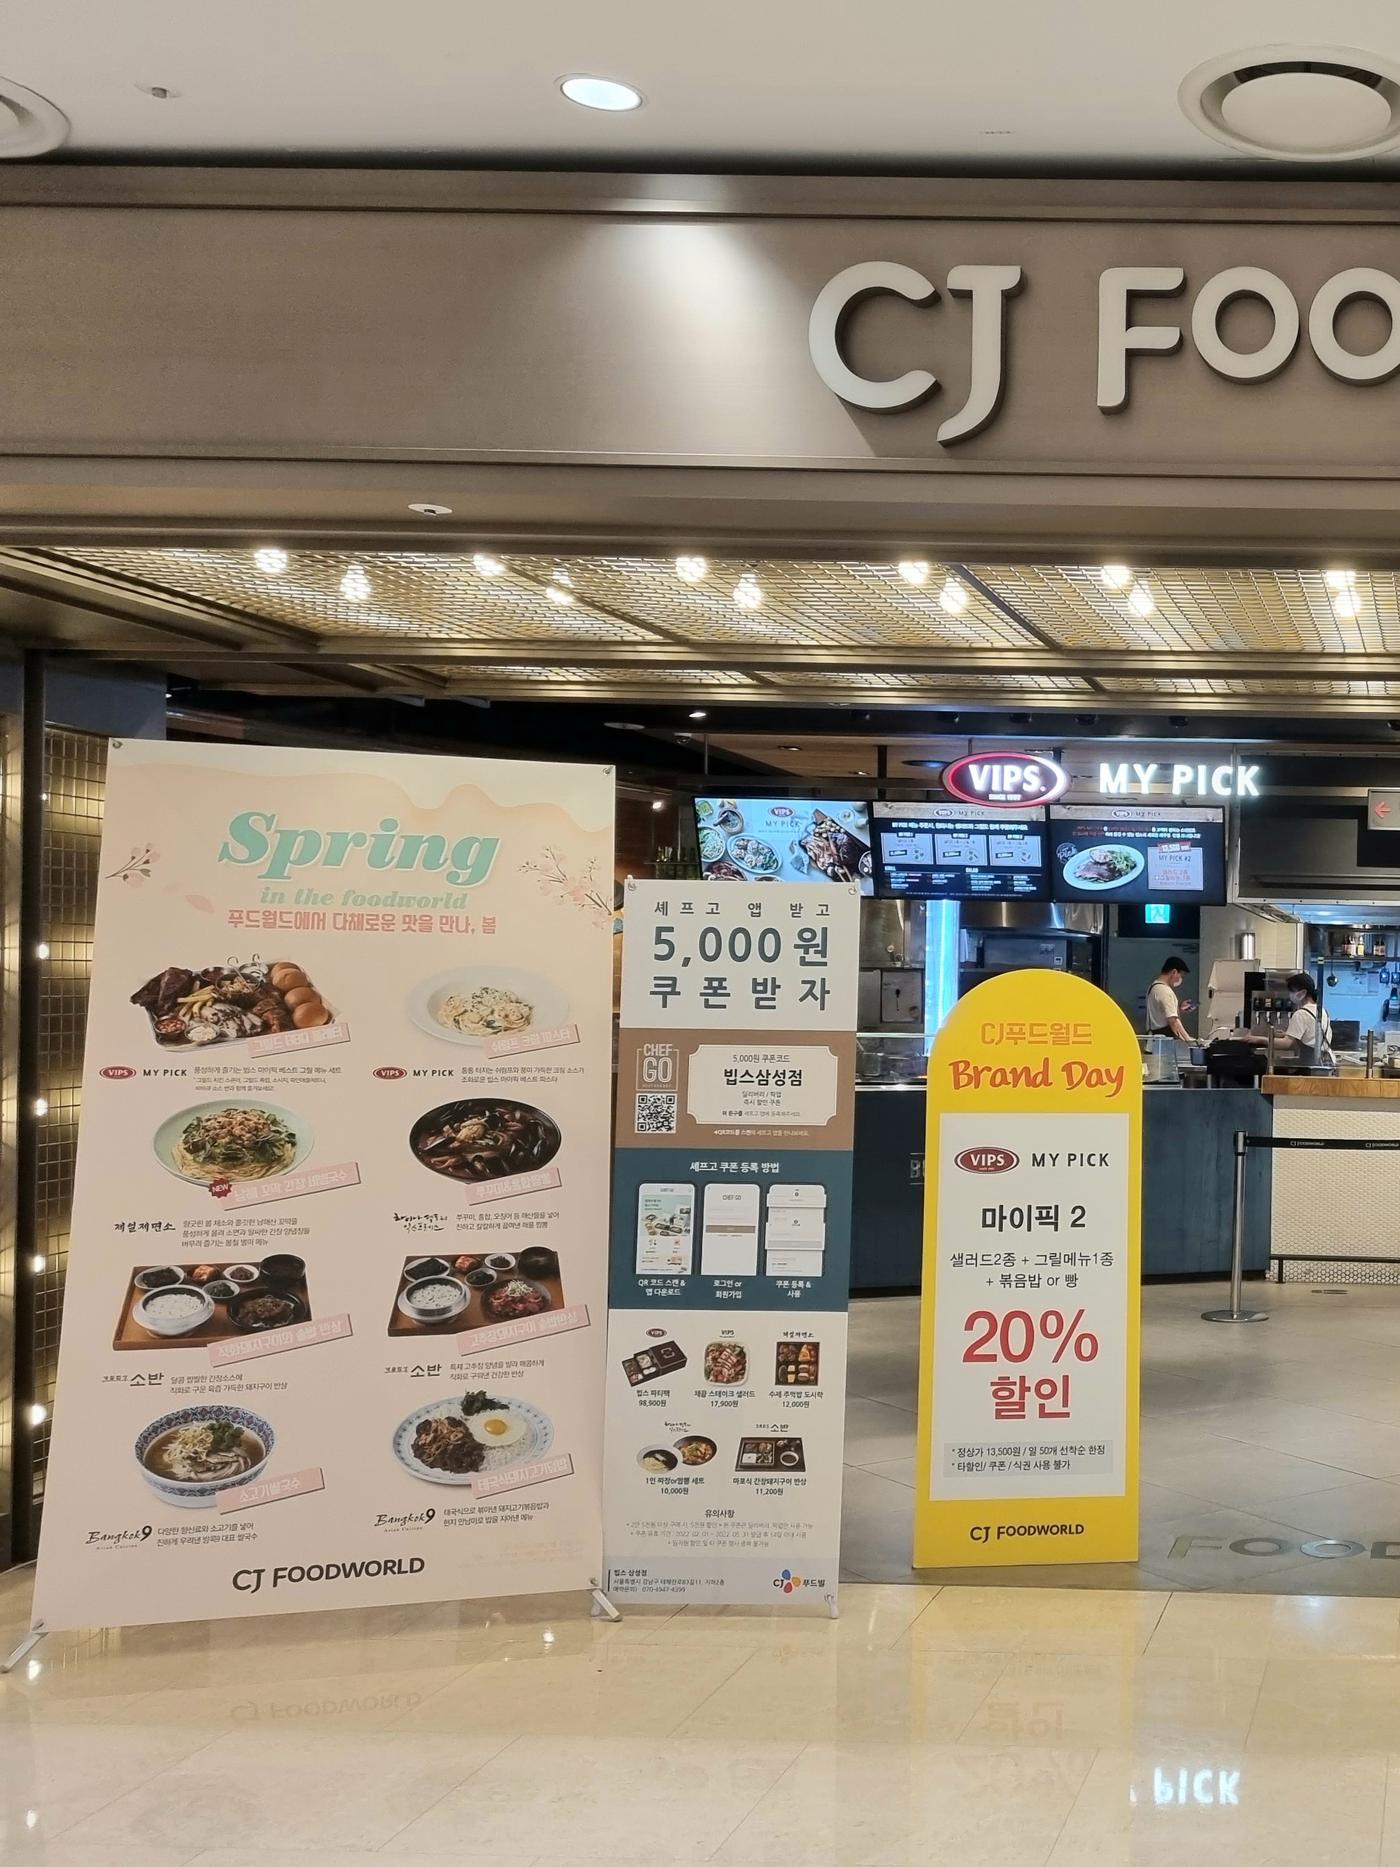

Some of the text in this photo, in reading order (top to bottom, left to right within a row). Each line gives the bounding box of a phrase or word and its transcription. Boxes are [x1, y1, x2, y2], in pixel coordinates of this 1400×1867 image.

[809, 261, 1023, 445] CJ
[1100, 763, 1157, 793] MY
[1172, 764, 1260, 796] PICK
[218, 811, 501, 887] Spring
[260, 886, 468, 910] in the foodworld
[227, 909, 326, 931] 푸드월드에서
[332, 912, 397, 932] 다채로운
[401, 914, 434, 933] 맛을
[481, 916, 496, 935] 봄
[653, 926, 829, 968] 5,000원
[981, 1022, 1093, 1046] CJ푸드월드
[643, 1043, 673, 1057] CHEF
[732, 1054, 791, 1064] 5,000원 쿠폰코드
[106, 1069, 188, 1078] VIPS MY PICK
[380, 1069, 455, 1077] VIPS MY PICK
[642, 1056, 673, 1083] GO
[723, 1068, 803, 1087] 빕스삼성점
[948, 1056, 1125, 1098] Brand Day
[969, 1153, 1110, 1167] VIPS MY PICK
[719, 1162, 780, 1173] 쿠폰 등록 방법
[211, 1182, 230, 1194] NEW
[981, 1204, 1087, 1233] 마이픽 2
[949, 1252, 1017, 1268] 샐러드2종
[1034, 1251, 1115, 1267] 그릴메뉴1종
[712, 1279, 734, 1288] 로그인
[999, 1273, 1079, 1289] 볶음밥 or 빵
[653, 1288, 681, 1297] 다운로드
[714, 1290, 742, 1300] 회원가입
[962, 1308, 1100, 1364] 20%
[410, 1363, 443, 1378] 소반
[129, 1372, 165, 1387] 소반
[636, 1389, 671, 1398] 빕스 파티팩
[708, 1390, 756, 1399] 스테이크 샐러드
[803, 1390, 824, 1399] 도시락
[989, 1374, 1071, 1421] 할인
[710, 1400, 739, 1409] 17,900원
[782, 1400, 810, 1409] 12,000원
[957, 1444, 1106, 1459] 정상가 13,500원 일 50개 선착순 한정
[988, 1460, 1008, 1472] 쿠폰
[1013, 1460, 1031, 1471] 식권
[1032, 1459, 1051, 1471] 사용
[1052, 1459, 1071, 1471] 불가
[793, 1477, 808, 1487] 반상
[660, 1487, 689, 1496] 10,000원
[755, 1488, 784, 1497] 11,200원
[704, 1509, 735, 1519] 유의사항
[969, 1523, 1085, 1544] CJ FOODWORLD
[232, 1557, 426, 1594] CJ FOODWORLD
[772, 1579, 826, 1589] CJ 푸드빌
